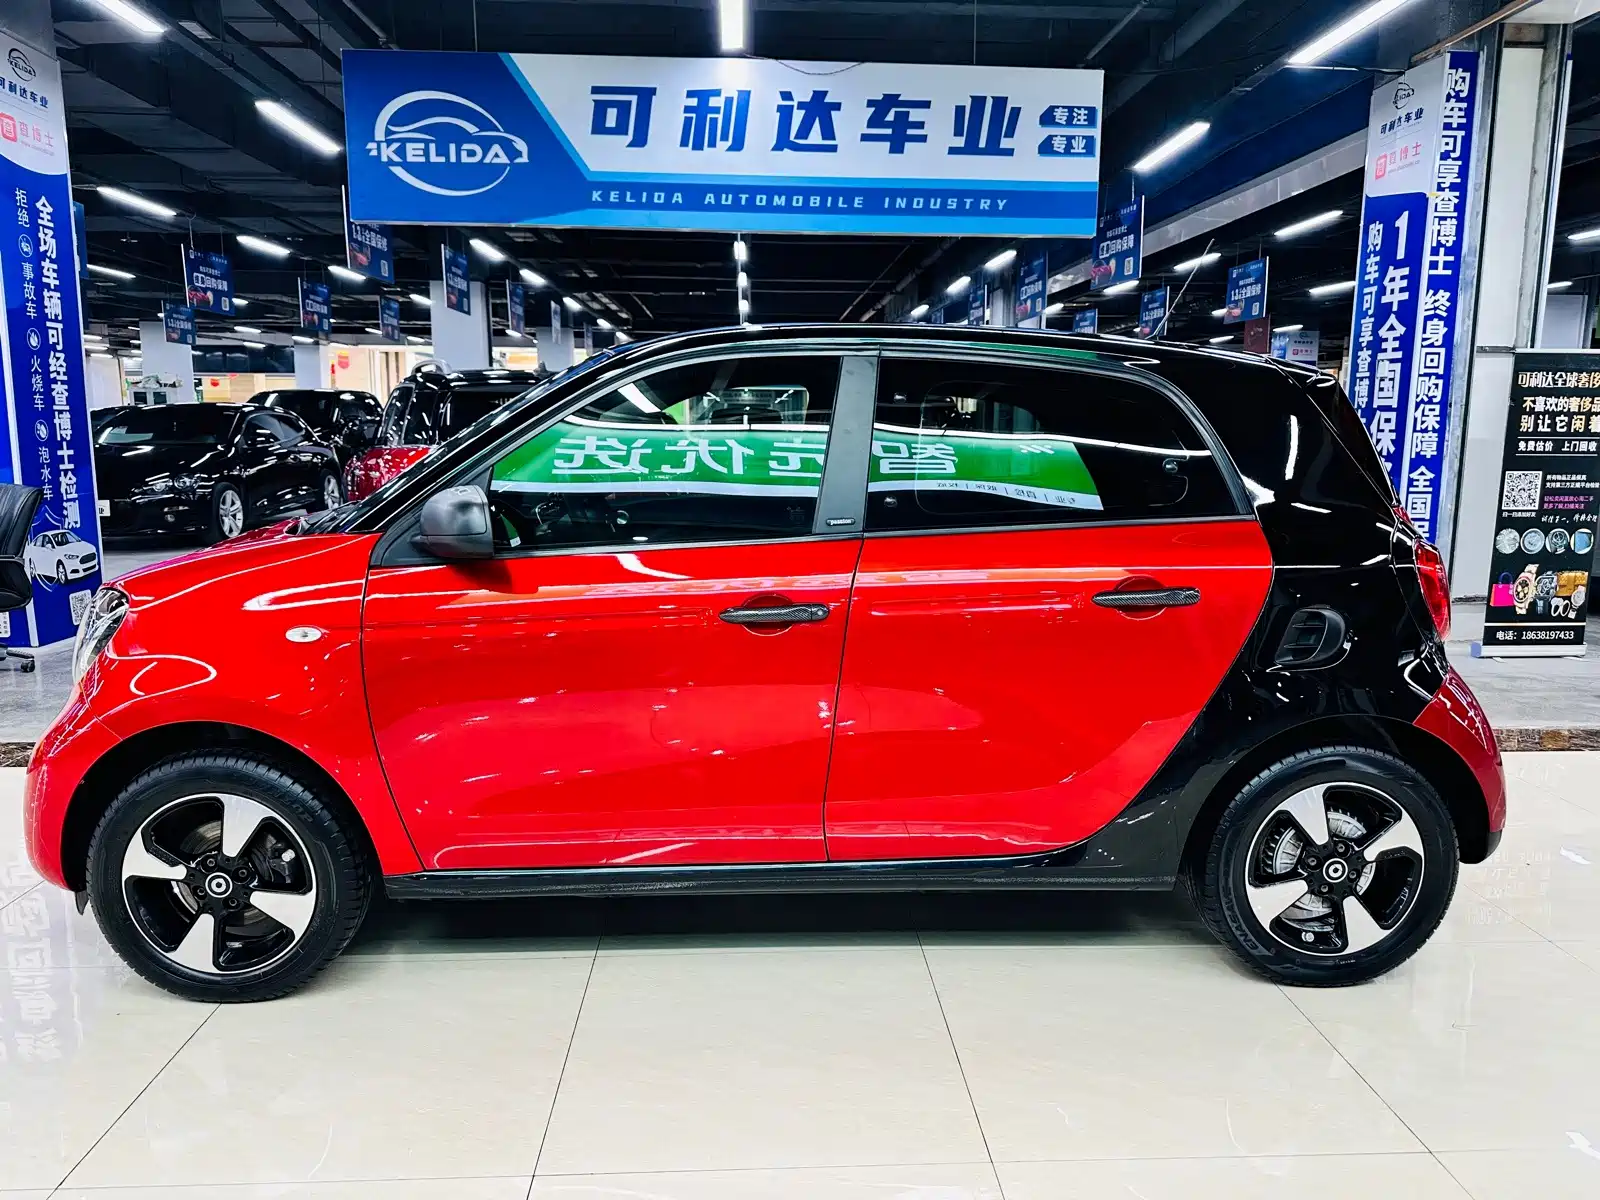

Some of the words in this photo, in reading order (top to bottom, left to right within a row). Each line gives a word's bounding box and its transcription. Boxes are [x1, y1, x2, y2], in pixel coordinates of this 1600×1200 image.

[589, 85, 1022, 157] 可利达车业
[1053, 107, 1089, 125] 专注
[380, 142, 511, 164] KELIDA
[1051, 135, 1087, 153] 专业
[1428, 68, 1471, 276] 购车可享查博士
[15, 187, 30, 228] 拒绝
[591, 190, 684, 204] KELIDA
[704, 193, 865, 208] AUTOMOBILE
[884, 197, 1008, 211] INDUSTRY
[21, 262, 38, 320] 事故车
[36, 195, 81, 530] 全场车辆可经查博士检测
[1370, 210, 1410, 481] 1年全国保
[31, 355, 45, 411] 火烧车
[1411, 289, 1452, 459] 终身回购保障
[1518, 440, 1553, 452] 免费估价
[1561, 440, 1597, 452] 上门回收
[1519, 414, 1600, 433] 别让它闲着
[38, 446, 54, 501] 泡水车
[1521, 630, 1575, 640] 18638197433
